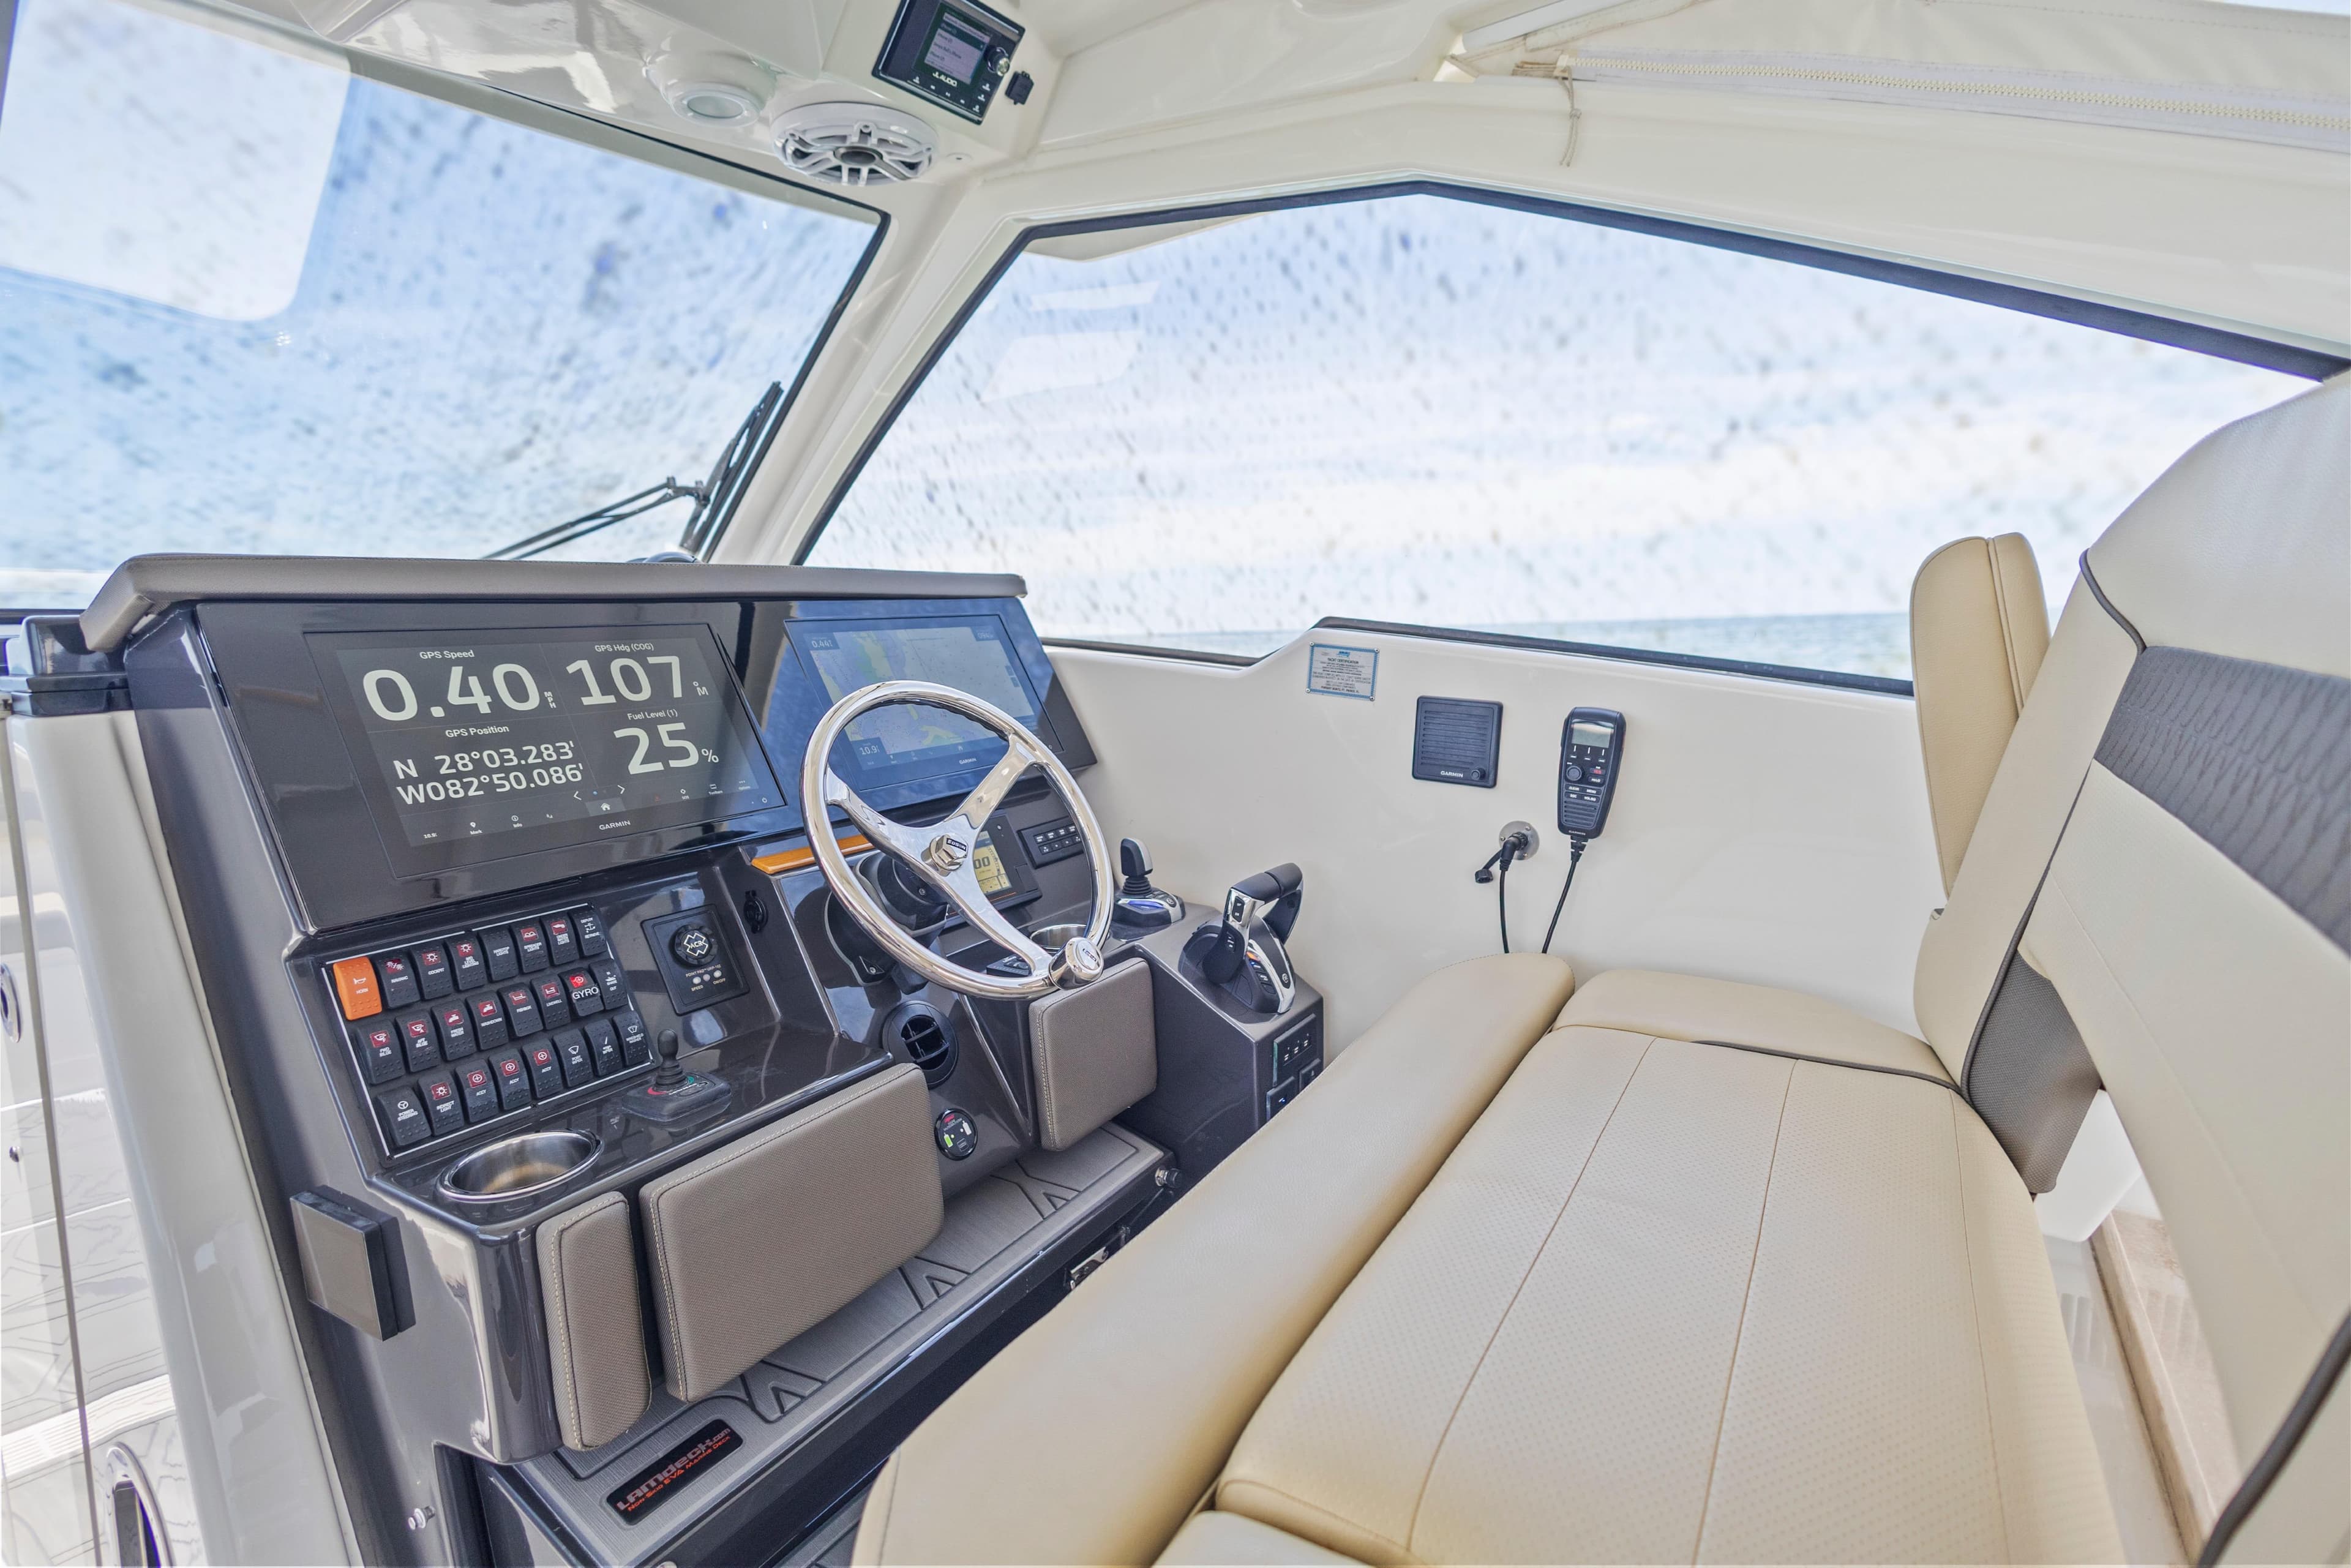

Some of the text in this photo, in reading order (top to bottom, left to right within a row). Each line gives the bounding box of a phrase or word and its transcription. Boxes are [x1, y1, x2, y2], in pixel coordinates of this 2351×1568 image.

[614, 643, 631, 652] Hdg
[631, 643, 654, 651] (COG)
[419, 650, 475, 659] GPS Speed
[566, 656, 682, 705] 107
[362, 663, 540, 721] 0.40
[627, 709, 678, 720] Fuel Level (1)
[446, 725, 509, 738] GPS Position
[613, 722, 719, 775] 25 %
[393, 741, 574, 779] N 28°03.283'
[599, 820, 631, 830] GARMIN
[689, 940, 703, 949] ACR
[572, 986, 599, 999] GYRO
[664, 1468, 684, 1485] EVA
